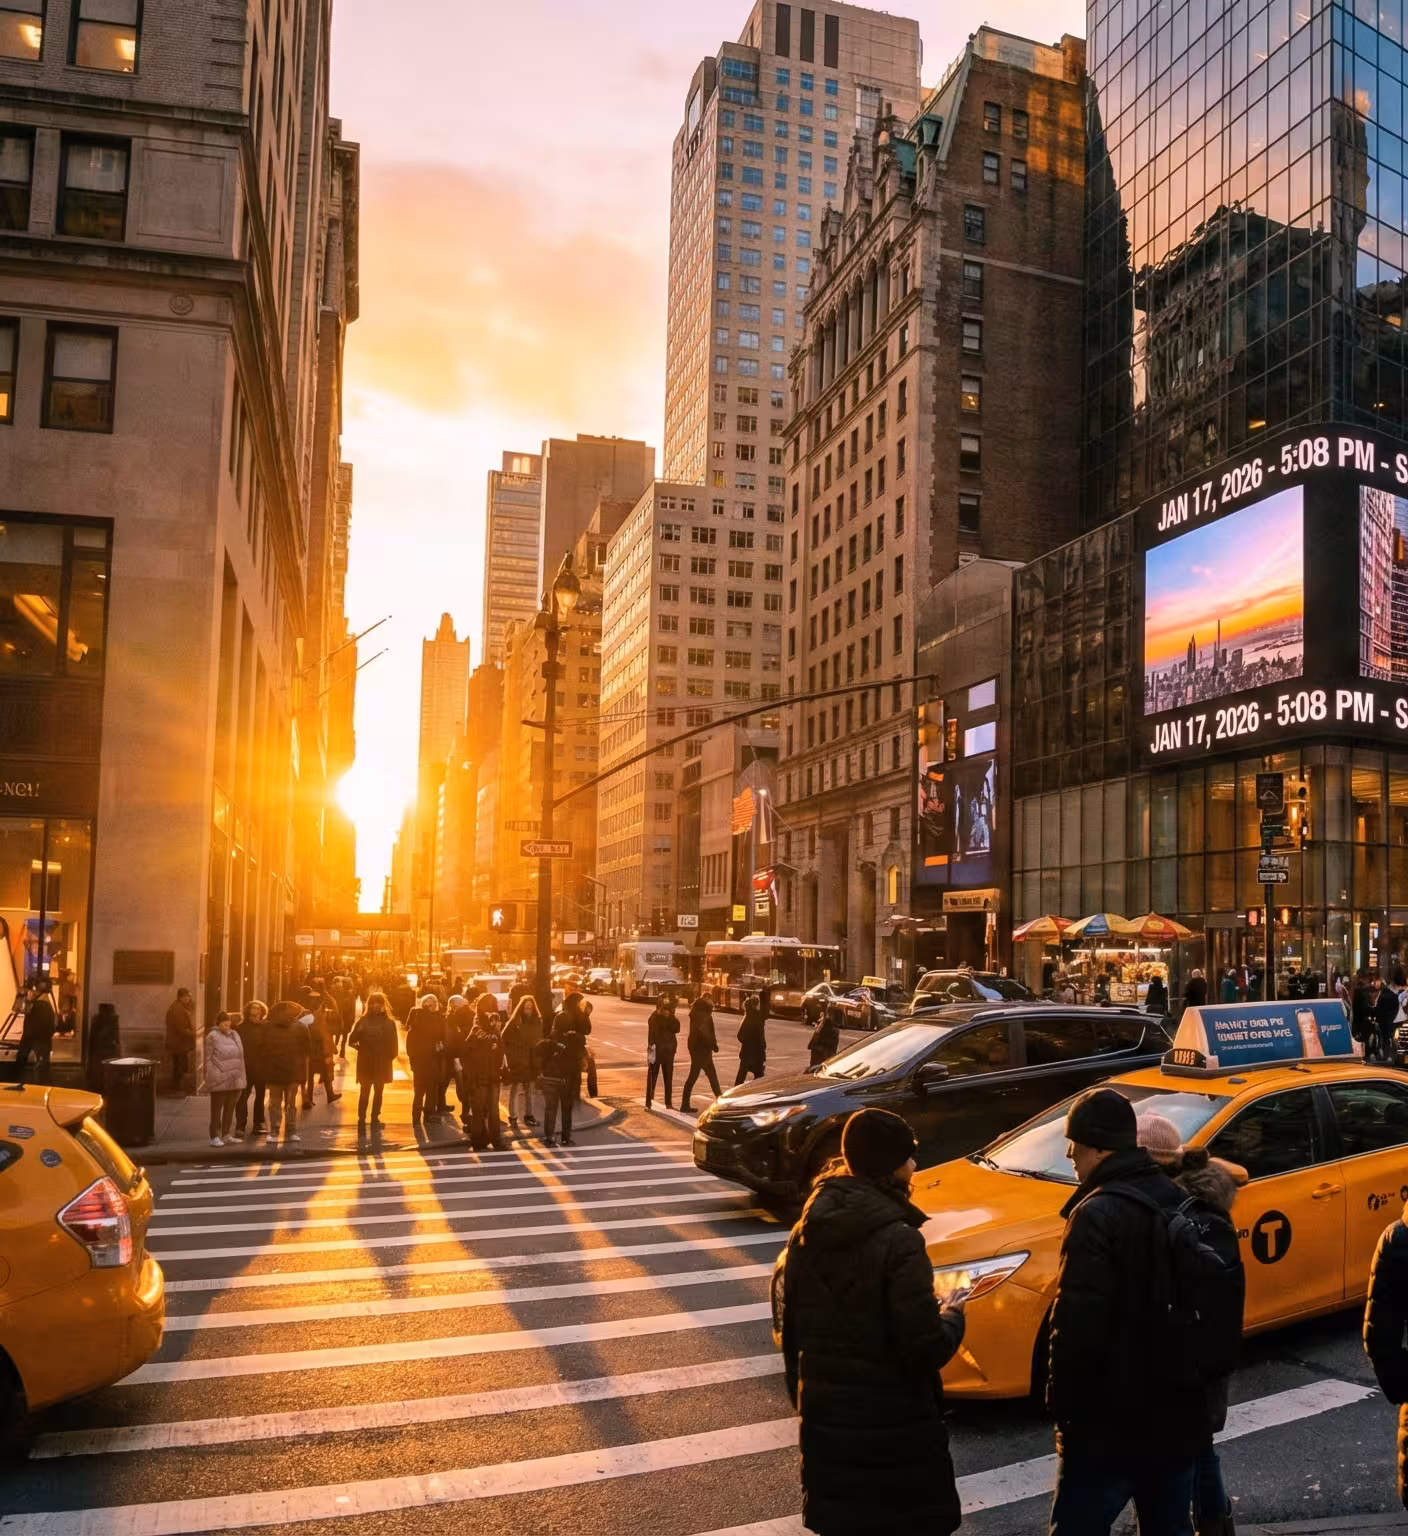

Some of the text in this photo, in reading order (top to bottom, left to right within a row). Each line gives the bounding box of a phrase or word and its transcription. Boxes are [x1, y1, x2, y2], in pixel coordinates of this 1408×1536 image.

[1157, 496, 1189, 532] JAN
[1193, 480, 1217, 513] 17,
[1221, 458, 1263, 503] 2026
[1281, 437, 1330, 476] 5:08
[1338, 437, 1375, 473] PM
[1150, 719, 1182, 754] JAN
[1185, 715, 1212, 750] 17,
[1215, 702, 1260, 739] 2026
[1277, 690, 1327, 726] 5:08
[1336, 690, 1374, 723] PM
[1260, 1220, 1283, 1259] T
